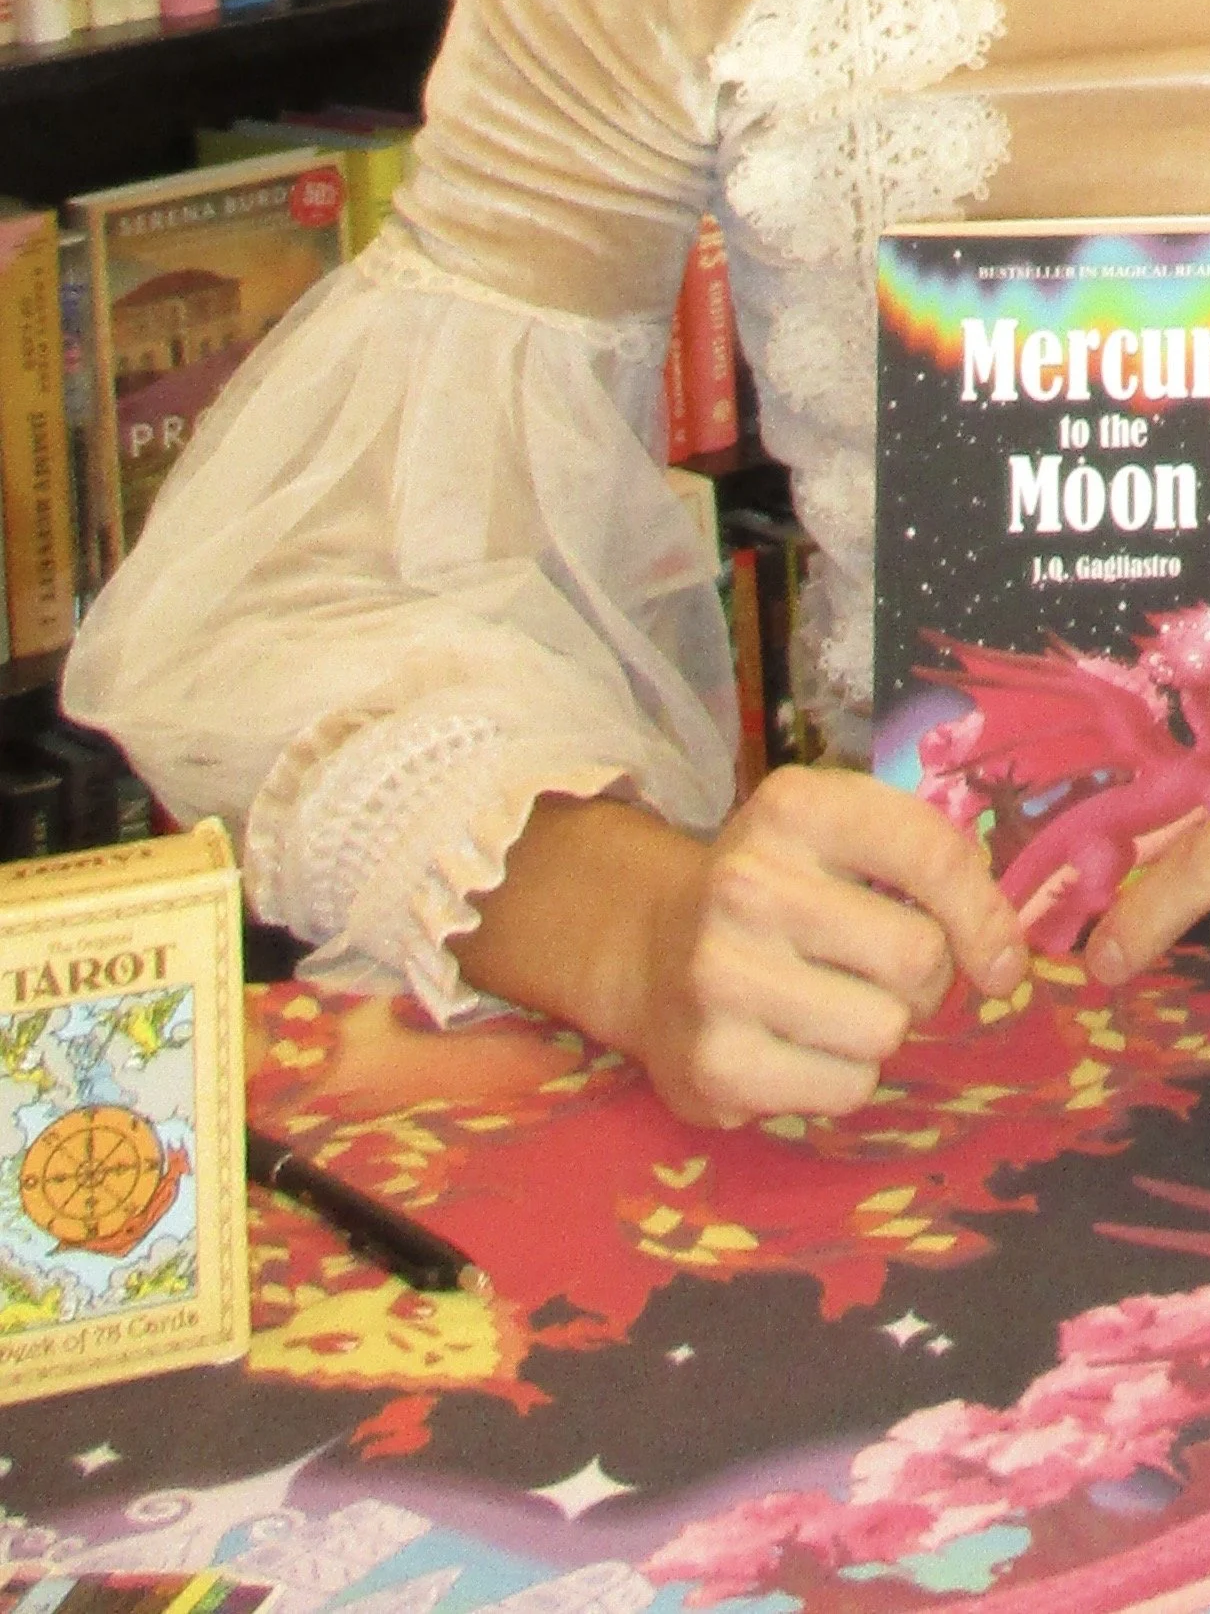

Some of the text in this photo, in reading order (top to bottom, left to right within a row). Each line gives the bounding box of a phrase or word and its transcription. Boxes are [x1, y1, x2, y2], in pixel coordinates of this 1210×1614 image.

[119, 204, 216, 236] SERENA
[978, 266, 1075, 281] BESTSELLER
[1079, 266, 1097, 279] IN
[1102, 266, 1170, 279] MAGICAL
[1058, 412, 1149, 450] to the
[1008, 453, 1199, 534] Moon
[1031, 554, 1182, 585] J.Q. Gagliastro
[3, 944, 178, 1003] TAROT
[64, 1327, 87, 1361] of
